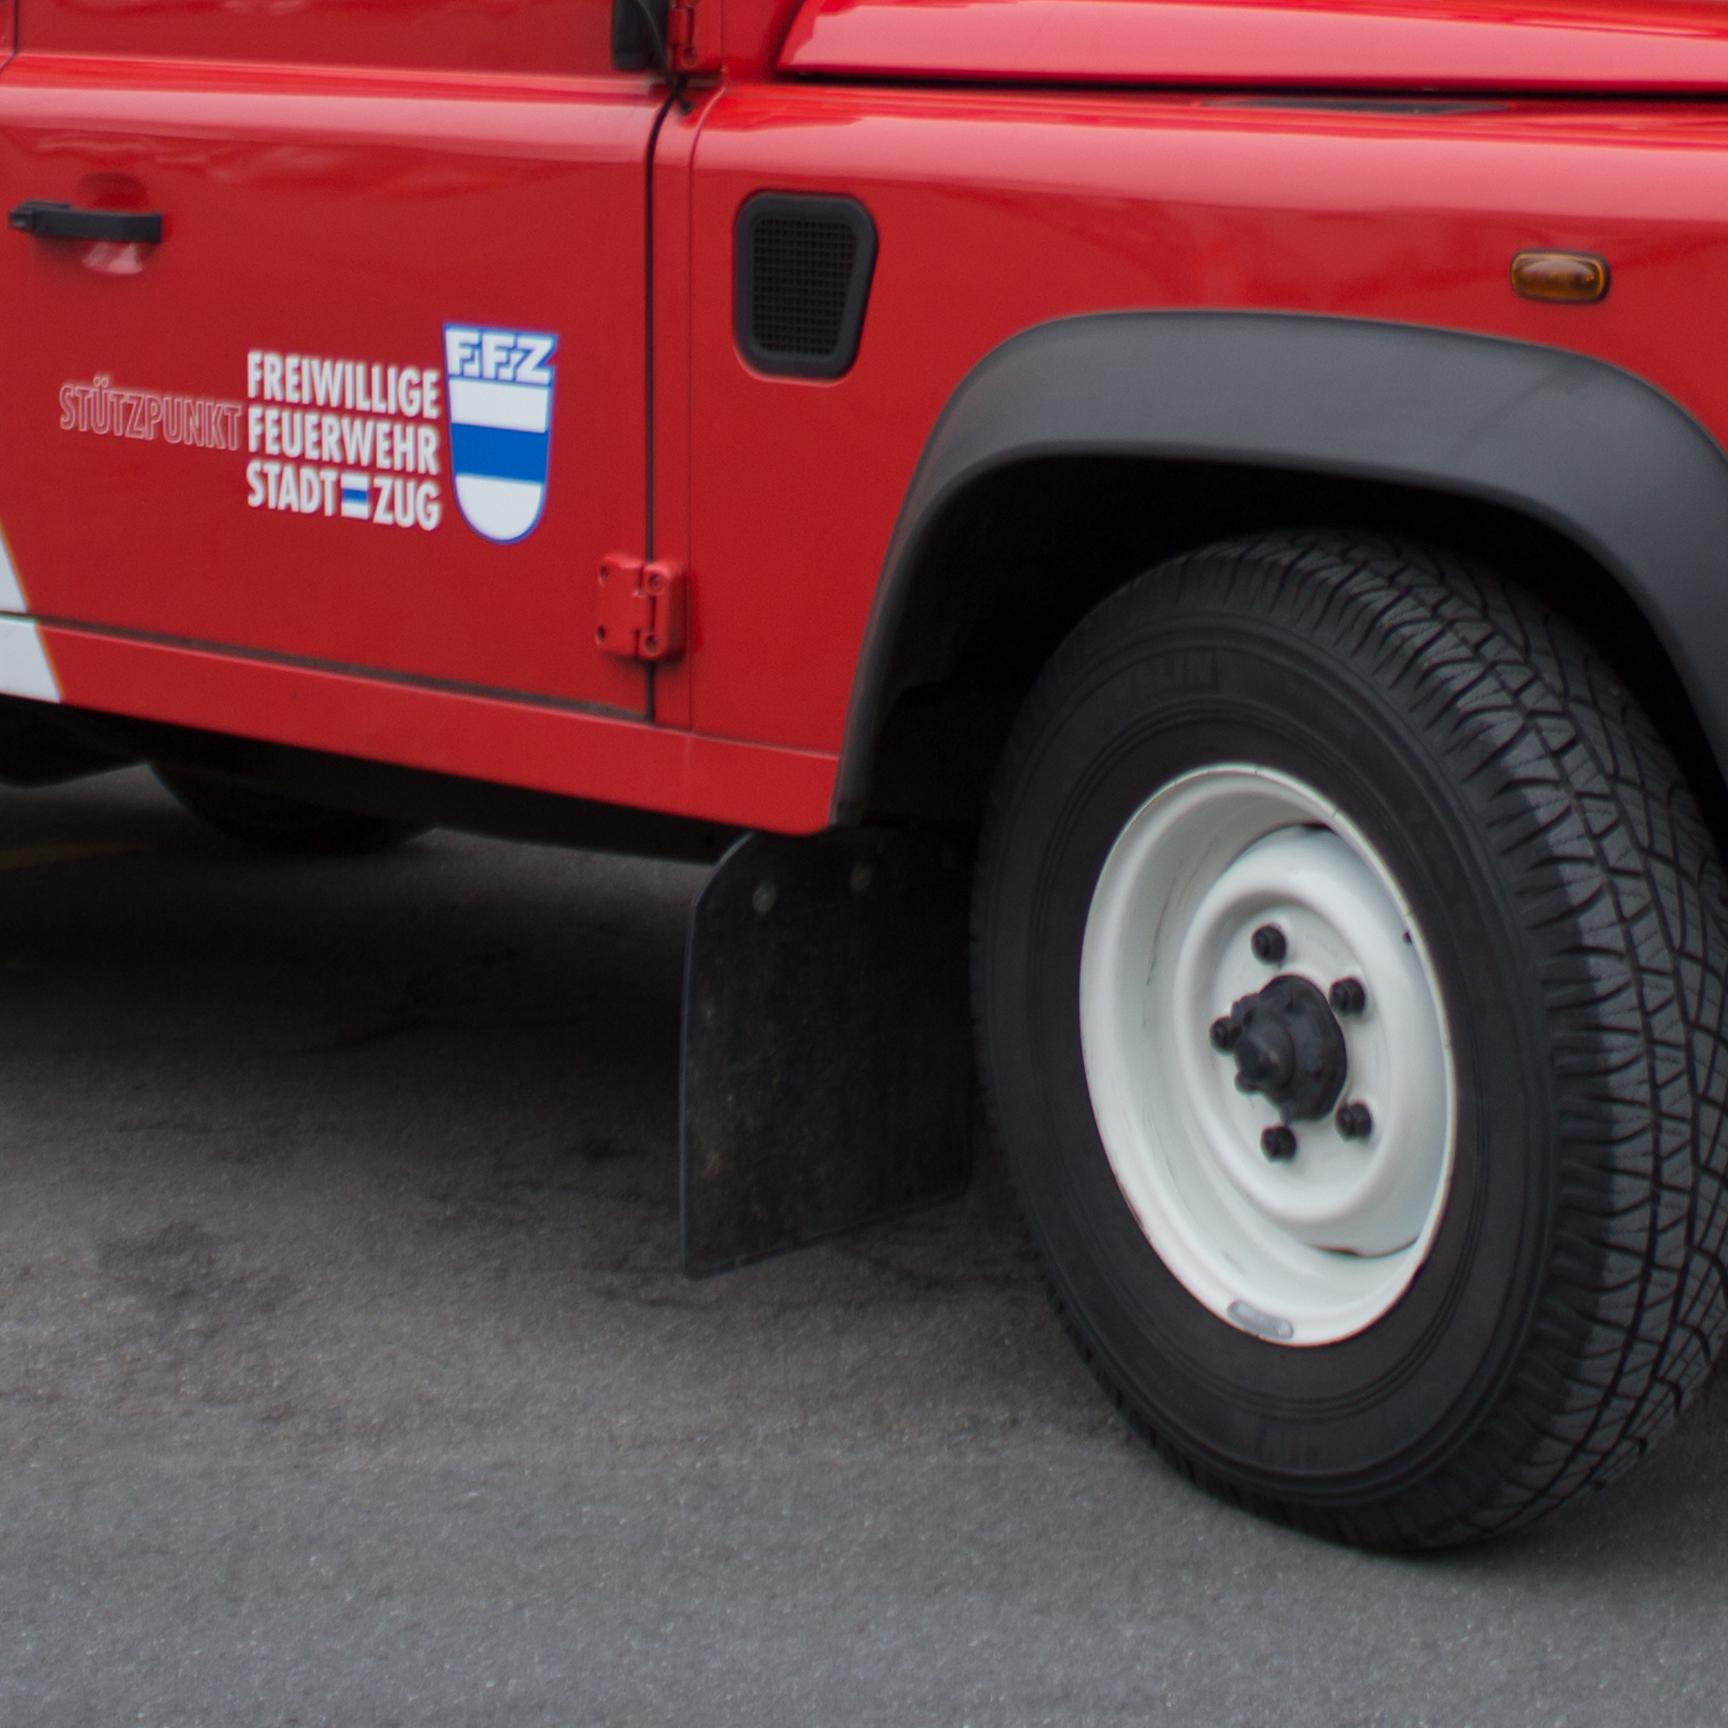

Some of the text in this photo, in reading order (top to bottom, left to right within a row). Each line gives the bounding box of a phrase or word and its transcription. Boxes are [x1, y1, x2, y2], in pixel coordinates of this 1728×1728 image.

[58, 374, 242, 451] STÜTZPUNKT
[246, 350, 440, 419] FREIWILLIGE
[246, 404, 439, 474] FEUERWEHR
[246, 458, 440, 532] STADT ZUG
